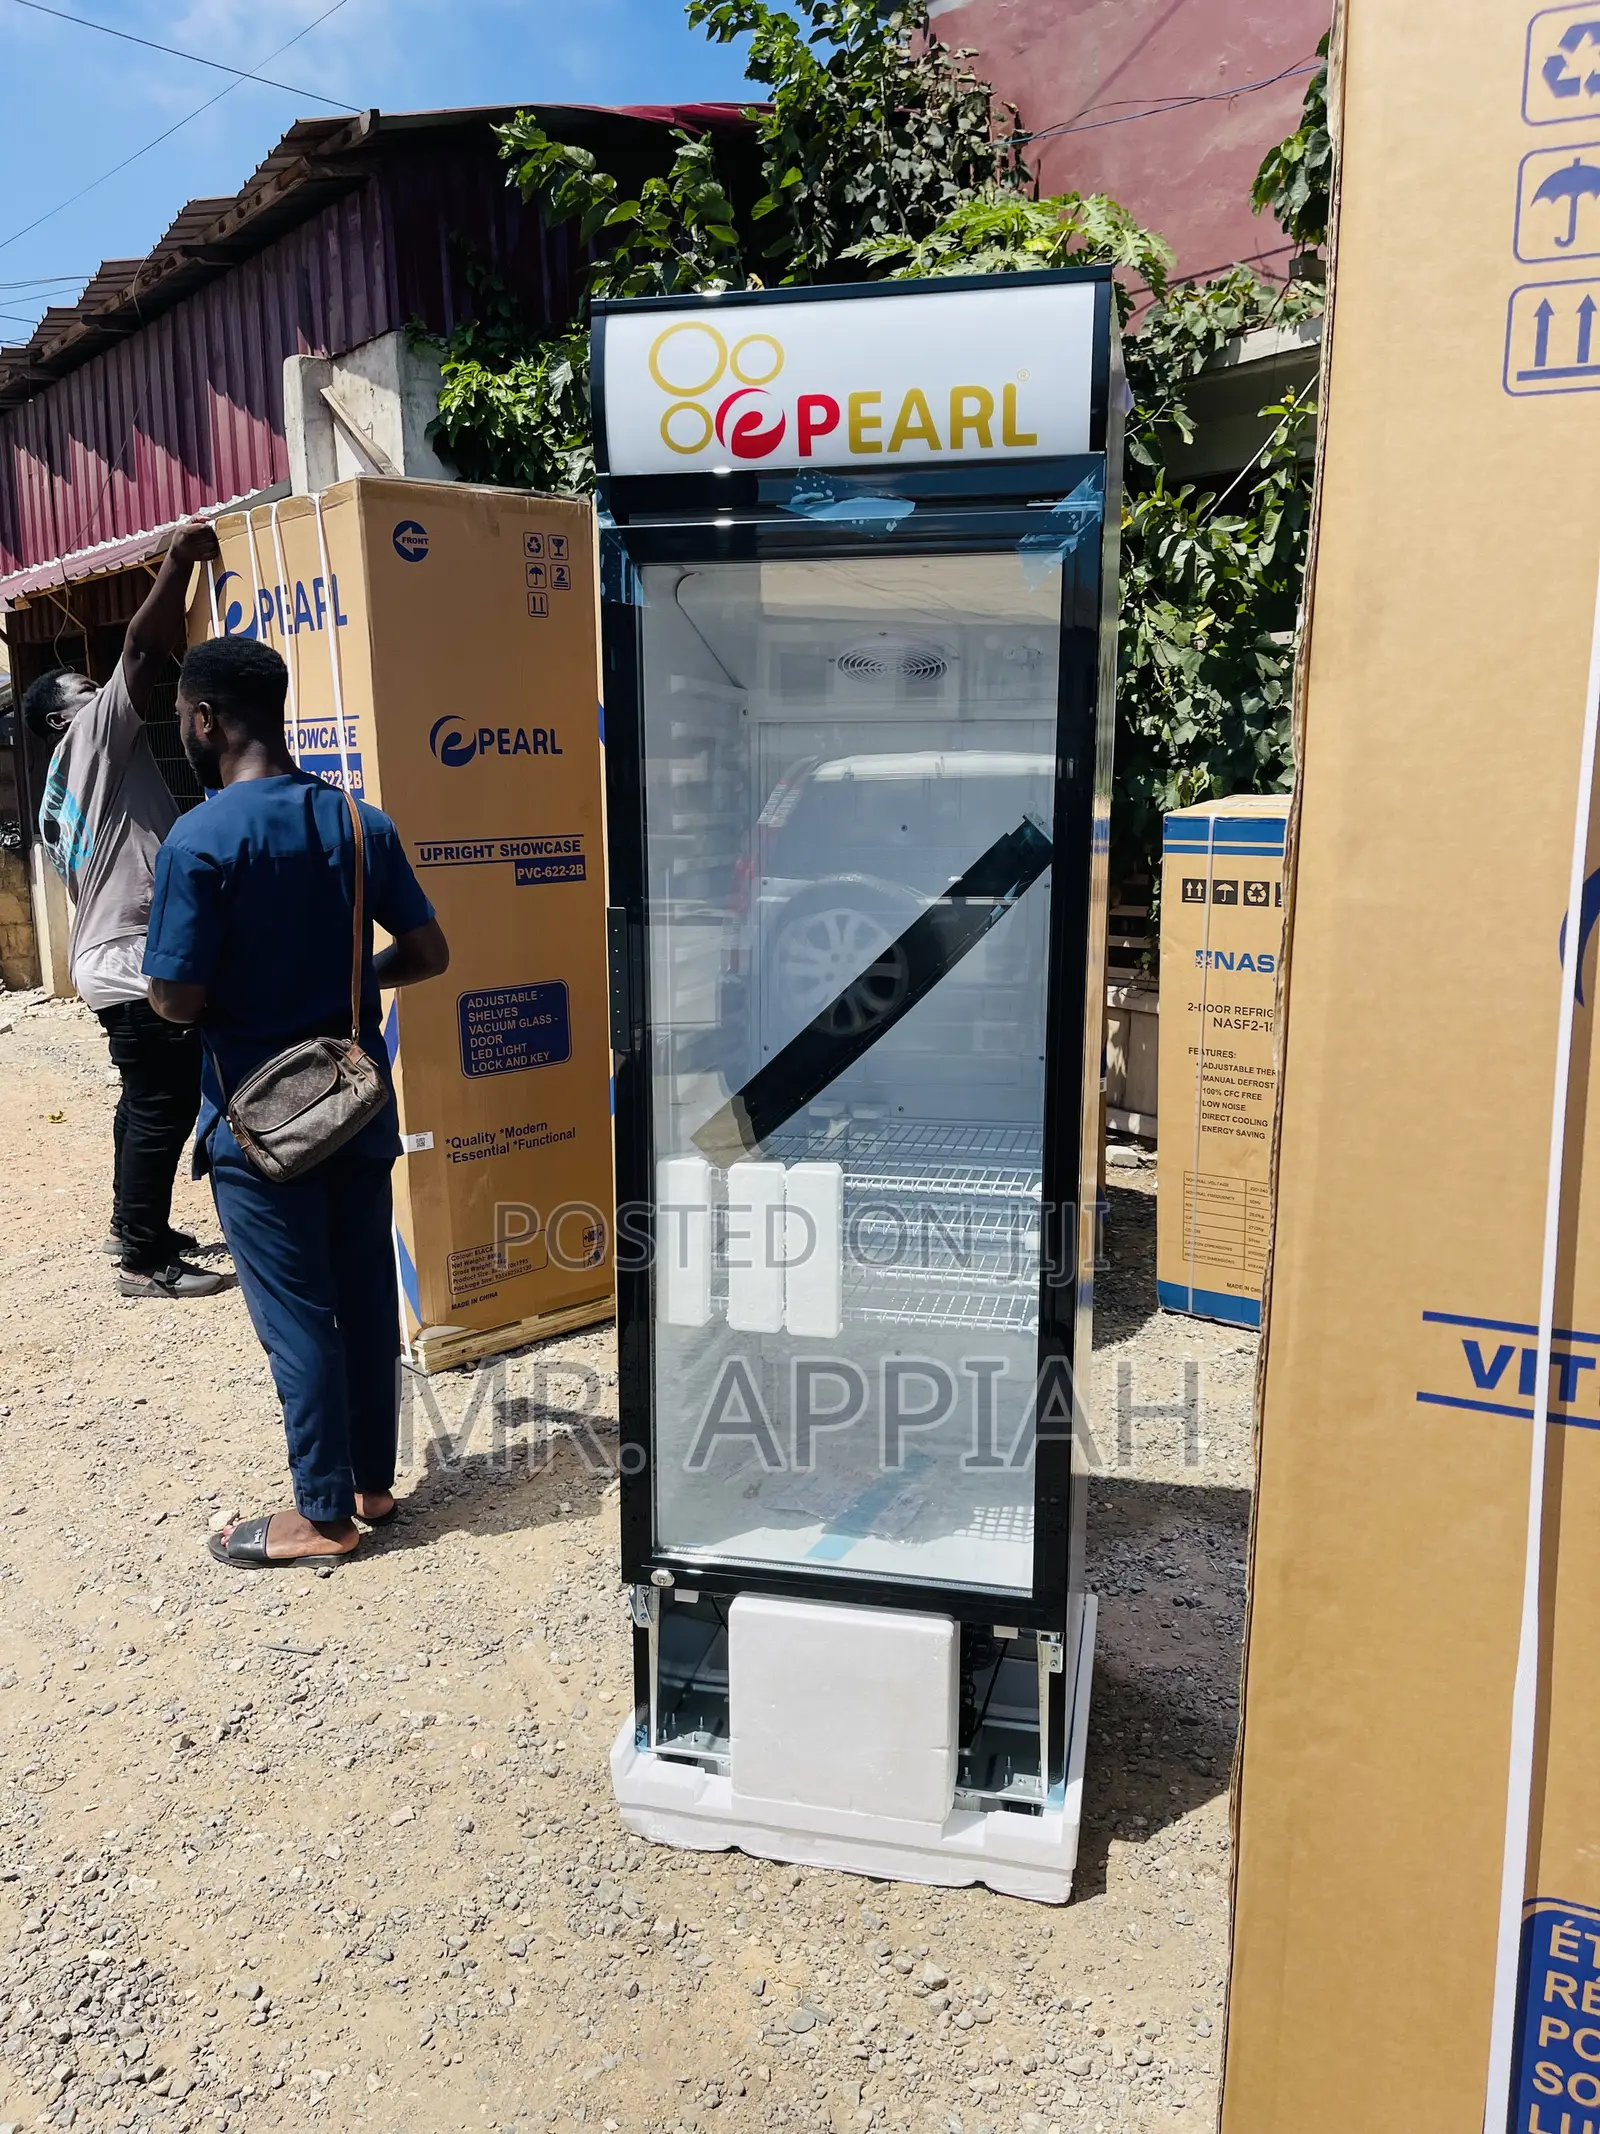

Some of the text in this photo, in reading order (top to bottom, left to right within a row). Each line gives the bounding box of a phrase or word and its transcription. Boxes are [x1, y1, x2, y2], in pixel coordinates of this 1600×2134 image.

[797, 382, 1038, 457] PEARL
[402, 537, 429, 546] FRONT
[478, 728, 563, 755] PEARL
[420, 840, 581, 861] UPRIGHT SHOWCASE
[516, 864, 585, 880] PVC-622-2B
[1215, 951, 1275, 973] NAS
[467, 991, 538, 1009] ADJUSTABLE
[468, 1007, 519, 1023] SHELVES
[469, 1019, 516, 1035] VACUUM
[519, 1014, 552, 1028] GLASS
[470, 1035, 503, 1048] DOOR
[471, 1042, 528, 1061] LED LIGHT
[472, 1051, 550, 1074] LOCK AND KEY
[1202, 1062, 1254, 1074] ADJUSTABLE
[1202, 1075, 1275, 1089] MANUAL DEFROST
[1202, 1088, 1262, 1101] 100% CFC FREE
[1202, 1100, 1246, 1111] LOW NOISE
[1201, 1112, 1268, 1127] DIRECT COOLING
[1201, 1125, 1266, 1140] ENERGY SAVING
[451, 1246, 494, 1261] Colour: BLACK
[452, 1268, 469, 1277] Gross
[453, 1274, 476, 1284] Product
[1226, 1282, 1242, 1290] MADE
[451, 1300, 469, 1310] MADE
[479, 1292, 498, 1302] CHINA
